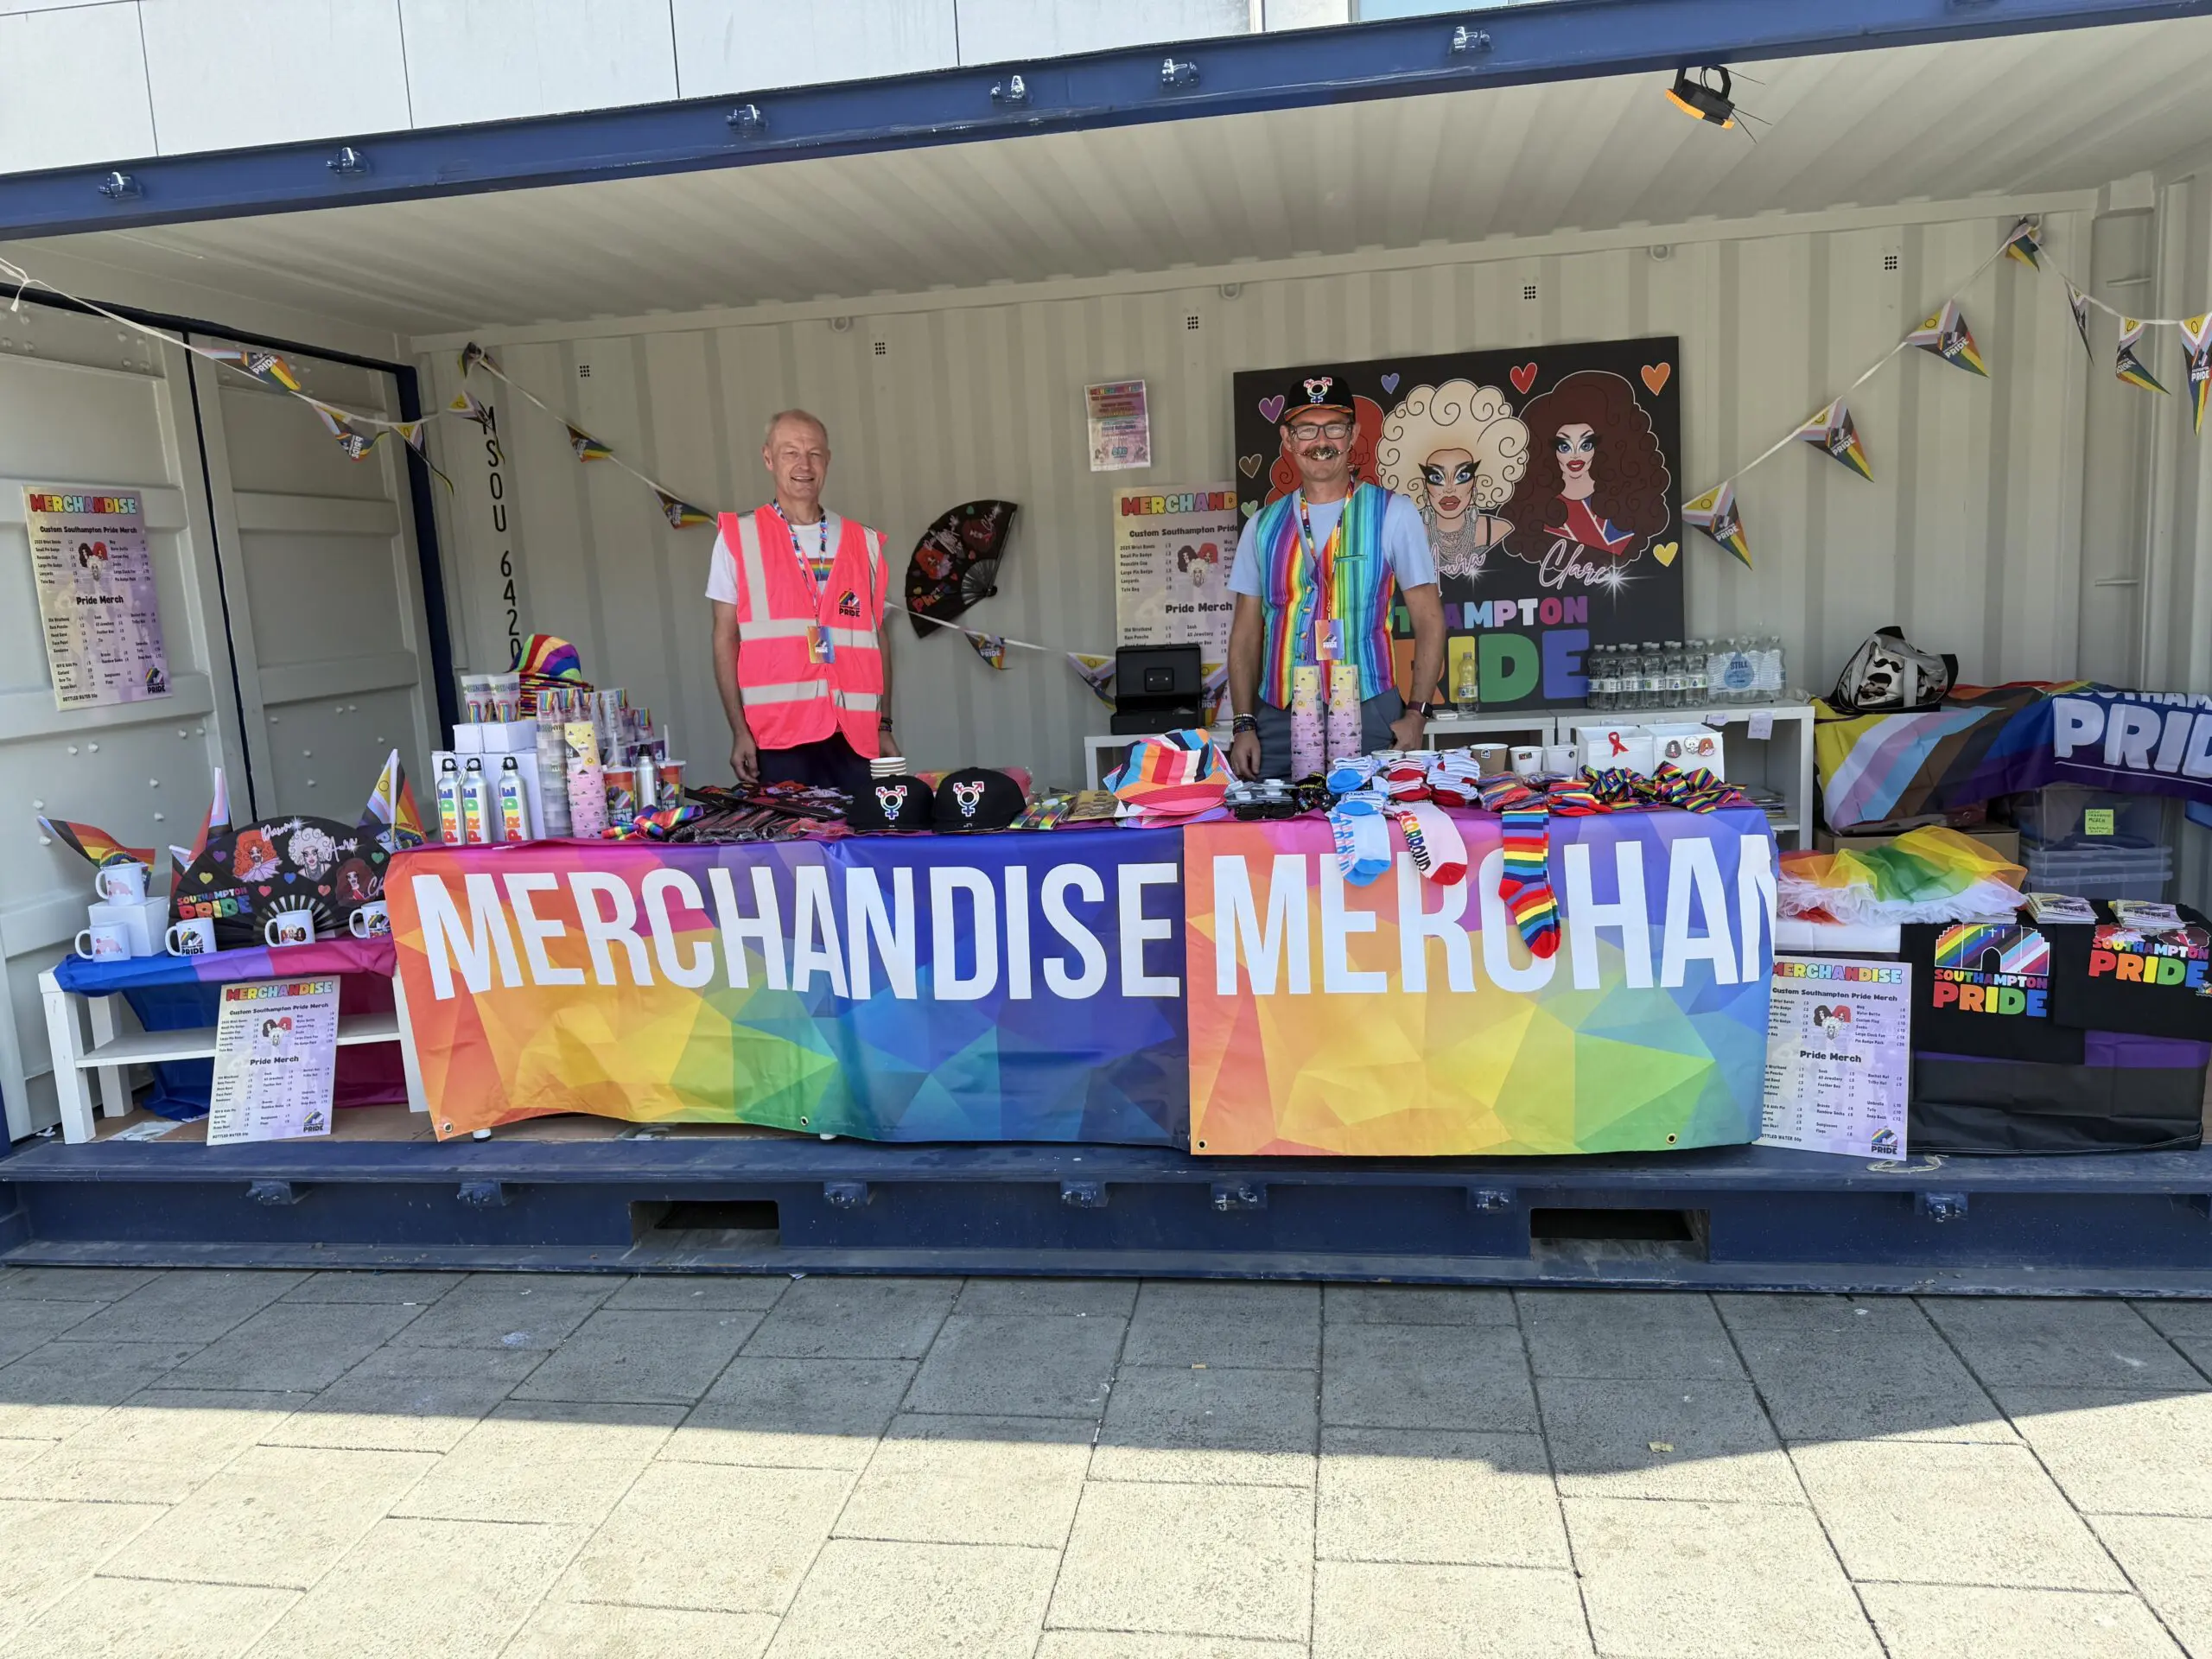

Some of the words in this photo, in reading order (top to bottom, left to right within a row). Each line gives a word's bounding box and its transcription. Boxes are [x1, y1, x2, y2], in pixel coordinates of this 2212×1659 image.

[1944, 336, 1969, 359] PRIDE
[252, 355, 278, 374] PRIDE
[2191, 371, 2210, 382] PRIDE
[1832, 435, 1857, 457] PRIDE
[29, 493, 137, 514] MERCHANDISE
[1161, 526, 1215, 537] Southampton
[1716, 525, 1739, 542] PRIDE
[1539, 538, 1612, 590] Clare
[76, 596, 98, 605] Pride
[99, 595, 124, 604] Merch
[1165, 603, 1195, 613] Pride
[1198, 601, 1233, 613] Merch
[839, 608, 861, 617] PRIDE
[1395, 596, 1588, 632] TAMPTON
[1731, 661, 1749, 670] STILL
[147, 684, 166, 694] PRIDE
[438, 788, 458, 842] PRIDE
[463, 788, 481, 842] PRIDE
[501, 787, 522, 842] PRIDE
[177, 887, 248, 906] SOUTHAMPTON
[179, 895, 253, 919] PRIDE
[412, 862, 1180, 1001] MERCHANDISE
[181, 946, 204, 955] PRIDE
[2092, 938, 2209, 960] SOUTHAMPTON
[1772, 961, 1903, 984] MERCHANDISE
[2088, 950, 2209, 988] PRIDE
[1934, 969, 2048, 989] SOUTHAMPTON
[226, 981, 333, 1001] MERCHANDISE
[1801, 989, 1849, 1000] Southampton
[1933, 982, 2048, 1018] PRIDE
[253, 1006, 291, 1014] Southampton
[273, 1055, 299, 1064] Merch
[1800, 1050, 1826, 1060] Pride
[1829, 1052, 1861, 1063] Merch
[1871, 1147, 1897, 1155] PRIDE
